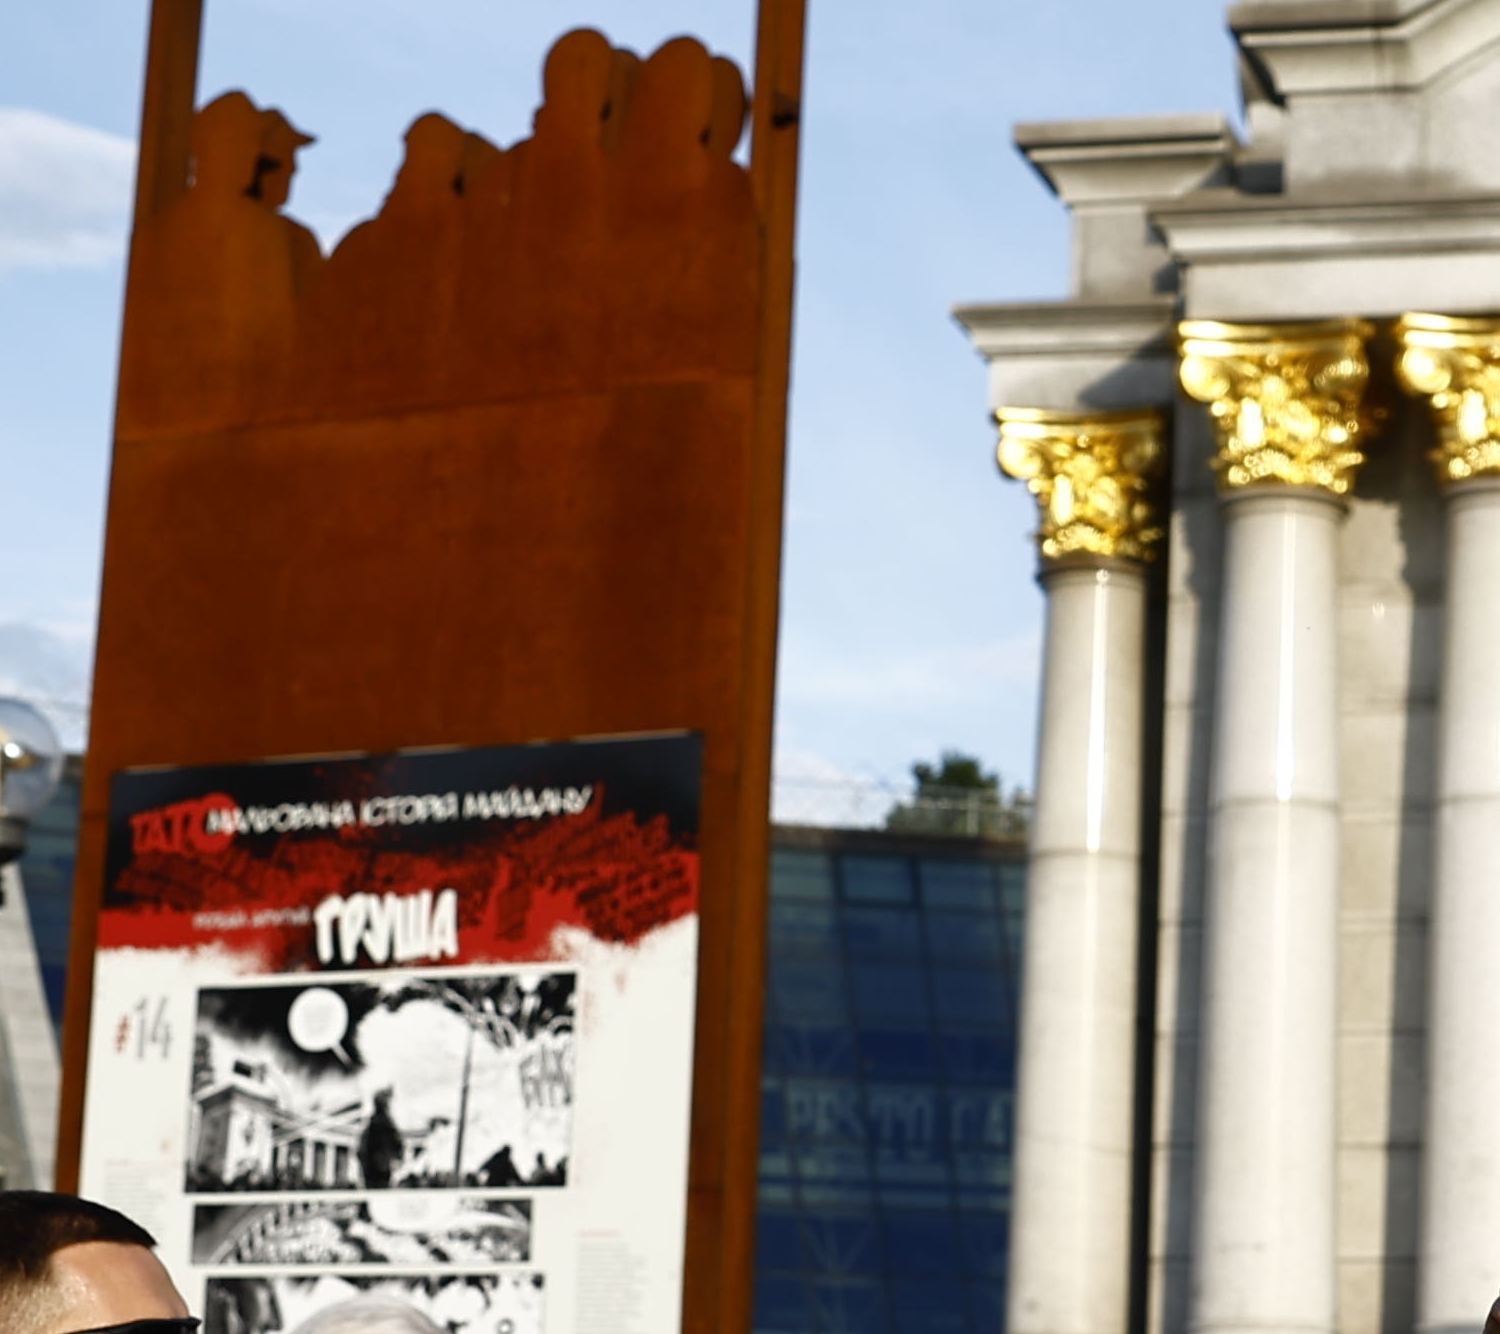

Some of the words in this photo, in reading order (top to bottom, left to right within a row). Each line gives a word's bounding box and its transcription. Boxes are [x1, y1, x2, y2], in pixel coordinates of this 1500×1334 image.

[205, 797, 357, 837] МАЛЬОВАНА
[360, 789, 459, 828] ІСТОРІЯ
[462, 783, 593, 819] МАЙДАНУ
[313, 888, 460, 966] ГРУША
